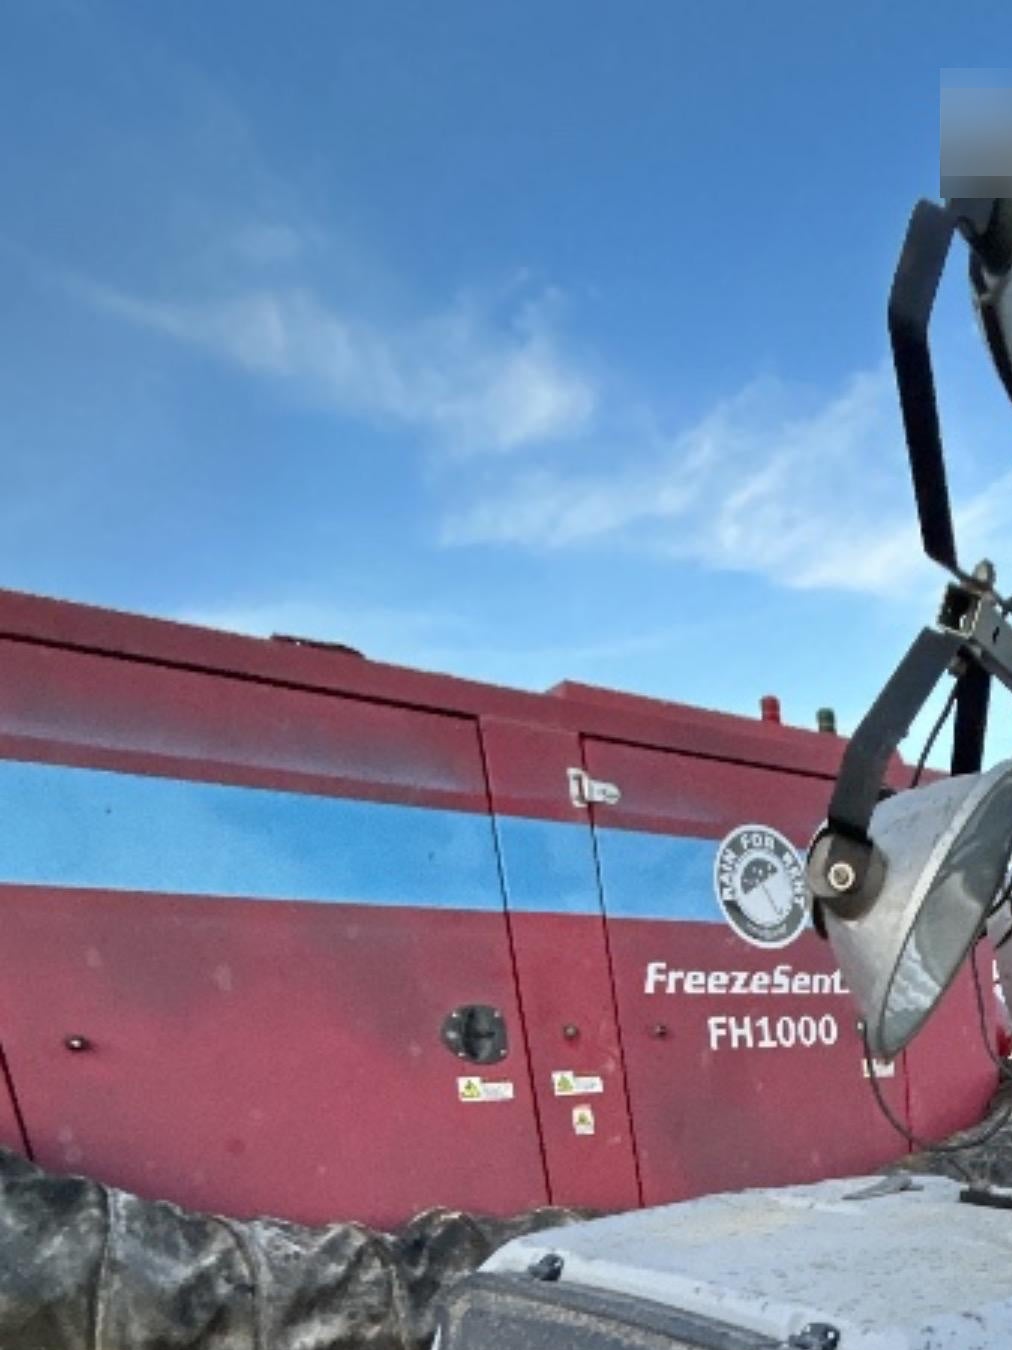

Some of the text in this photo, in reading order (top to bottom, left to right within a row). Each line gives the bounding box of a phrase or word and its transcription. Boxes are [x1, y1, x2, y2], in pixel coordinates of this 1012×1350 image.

[740, 833, 775, 849] FOR
[644, 962, 851, 994] FreezeSent
[707, 1013, 839, 1050] FH1000
